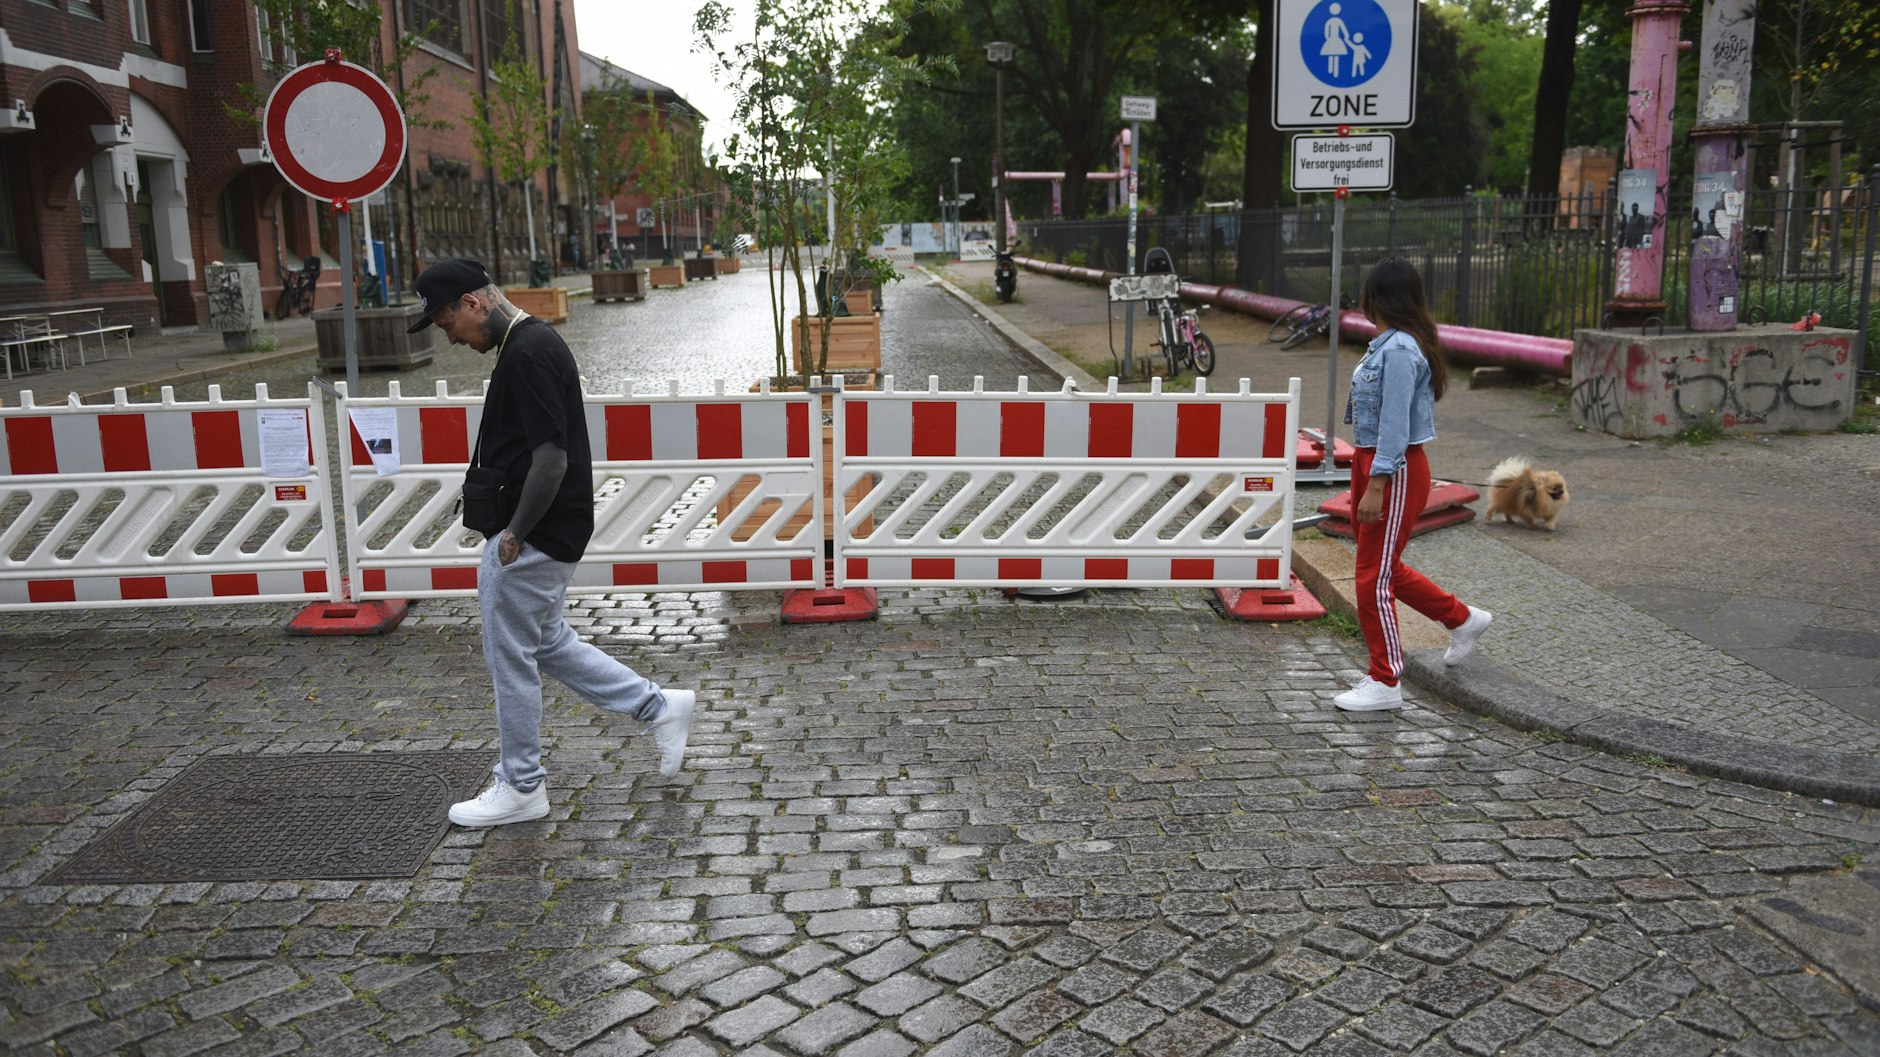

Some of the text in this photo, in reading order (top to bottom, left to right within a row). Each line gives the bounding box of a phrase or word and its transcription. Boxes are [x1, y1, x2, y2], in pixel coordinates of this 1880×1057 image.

[1310, 94, 1378, 117] ZONE
[1300, 157, 1384, 171] Versorgungsdienst
[1333, 174, 1350, 185] frei
